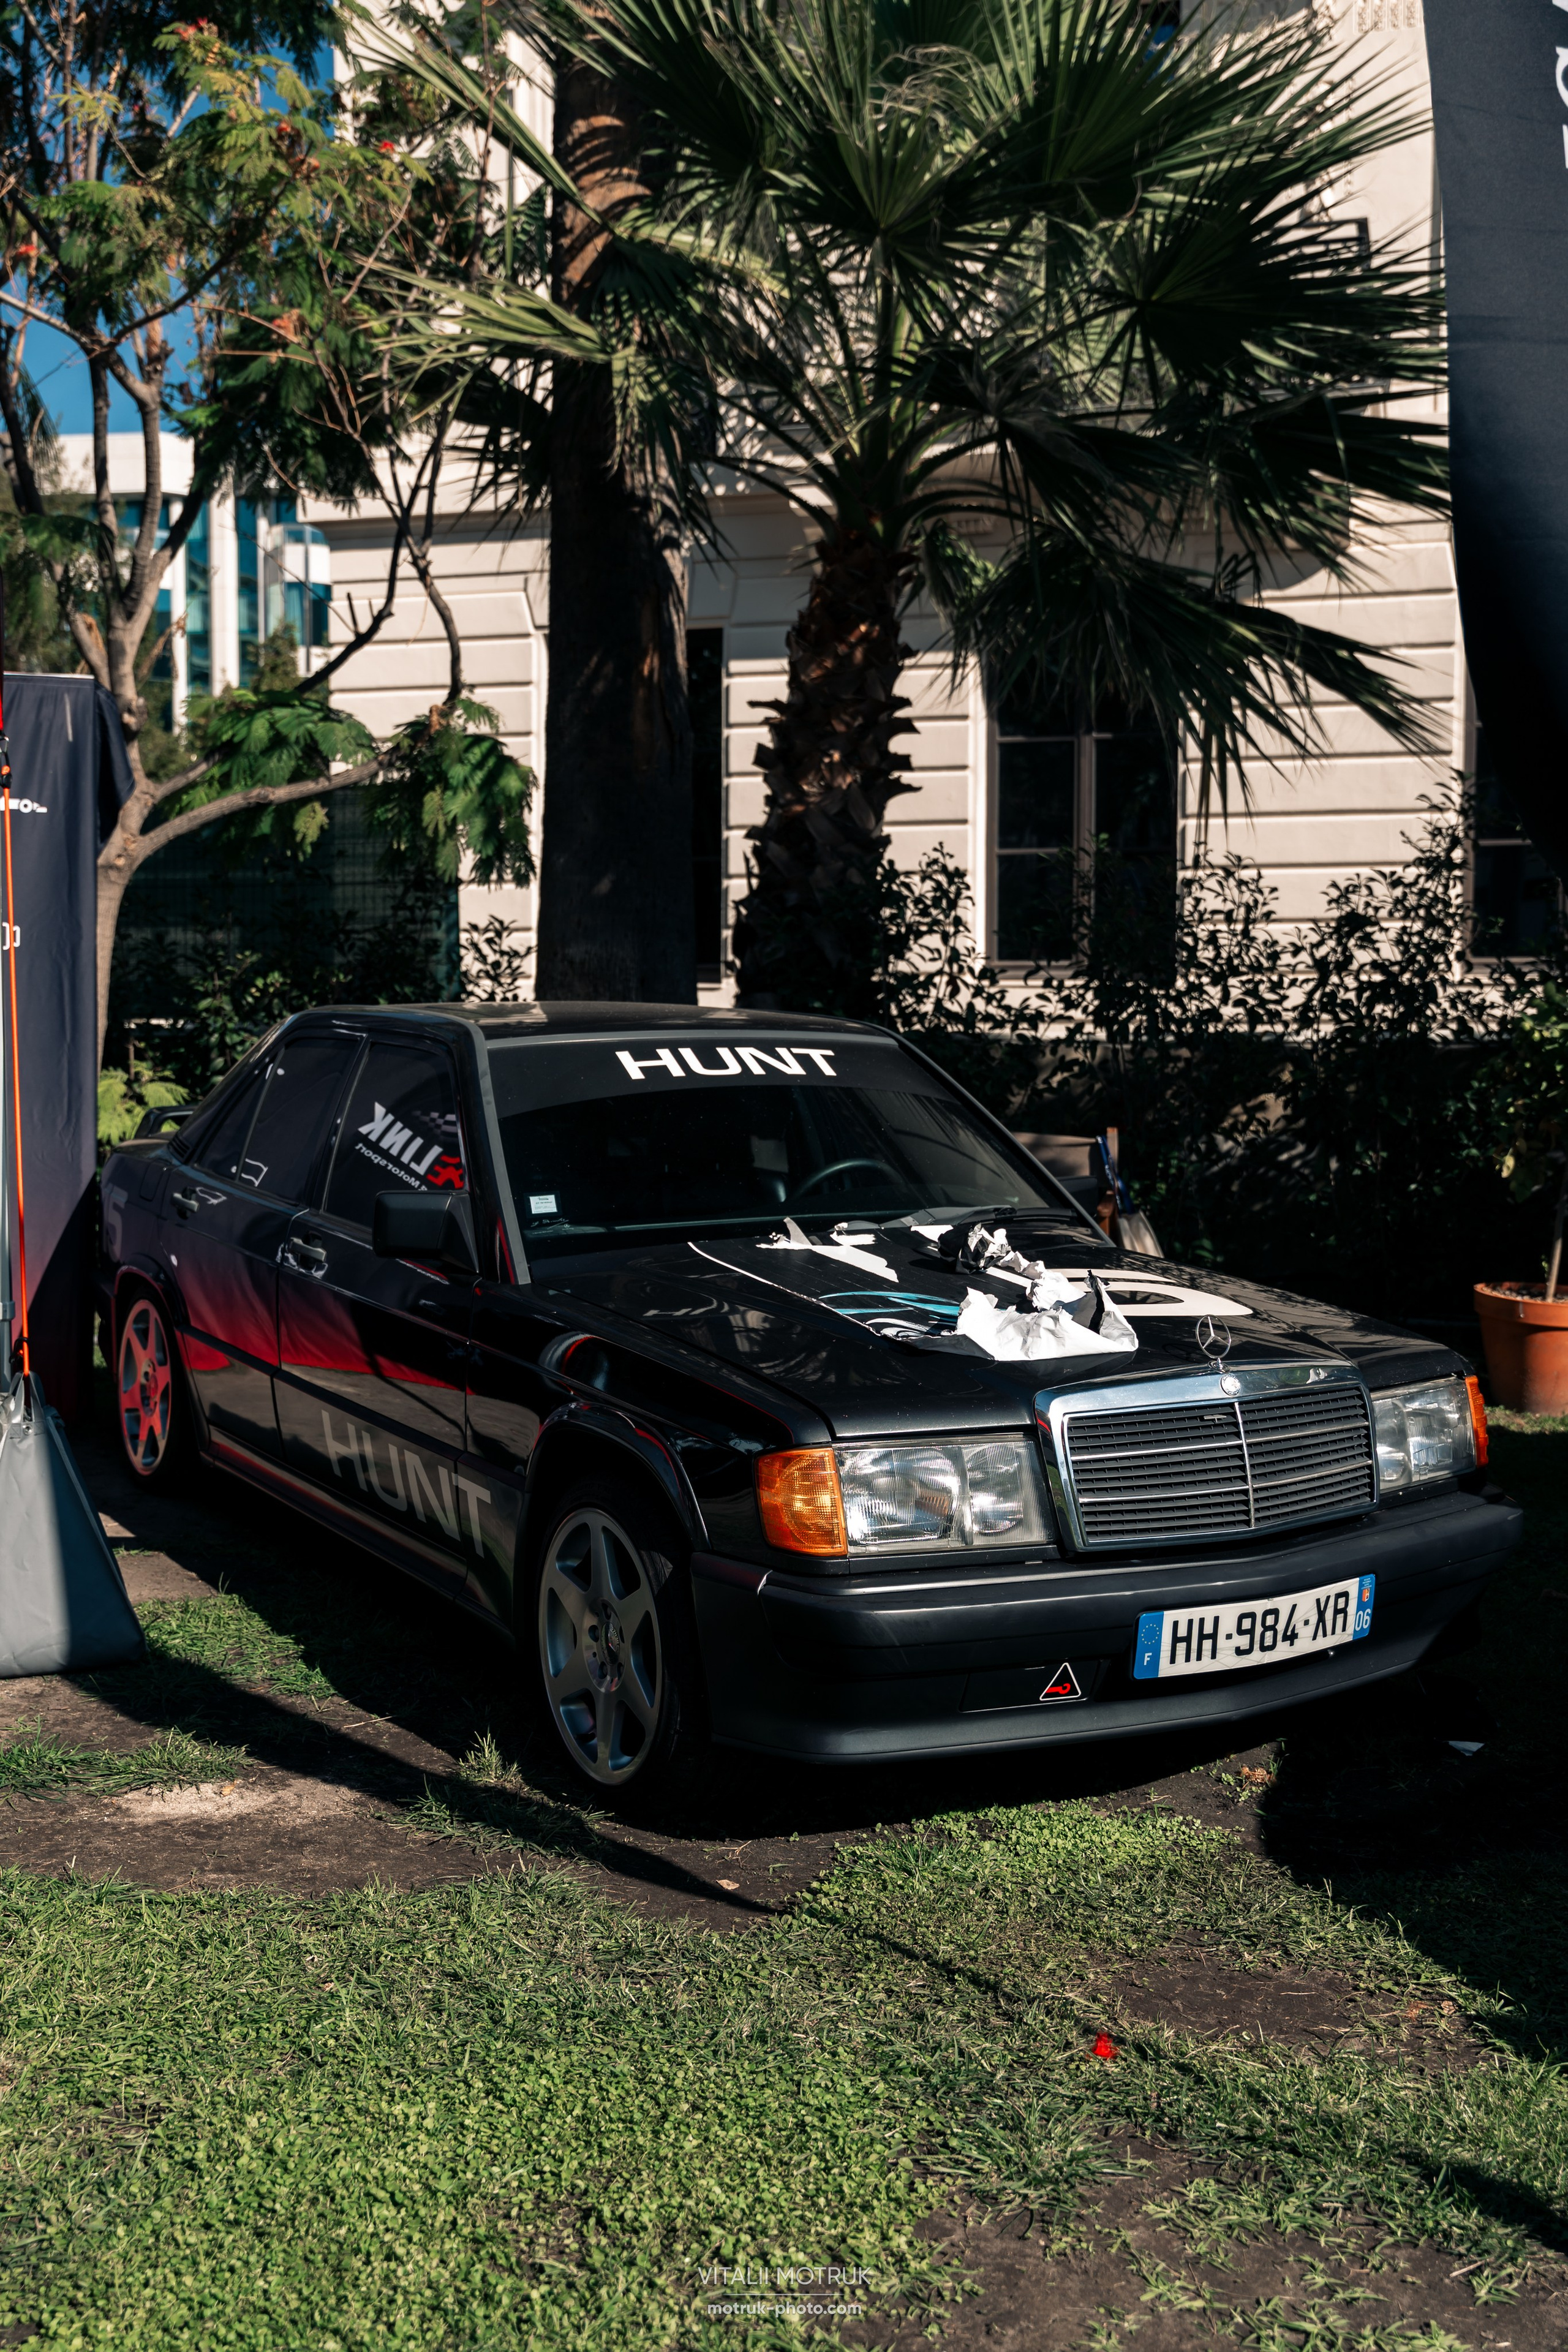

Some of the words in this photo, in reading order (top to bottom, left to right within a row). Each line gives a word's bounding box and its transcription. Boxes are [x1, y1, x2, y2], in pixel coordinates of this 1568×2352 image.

[615, 1047, 836, 1080] HUNT
[322, 1409, 491, 1559] HUNT
[1169, 1591, 1350, 1665] HH-984-XR
[1355, 1608, 1371, 1631] 06
[1144, 1653, 1153, 1665] F
